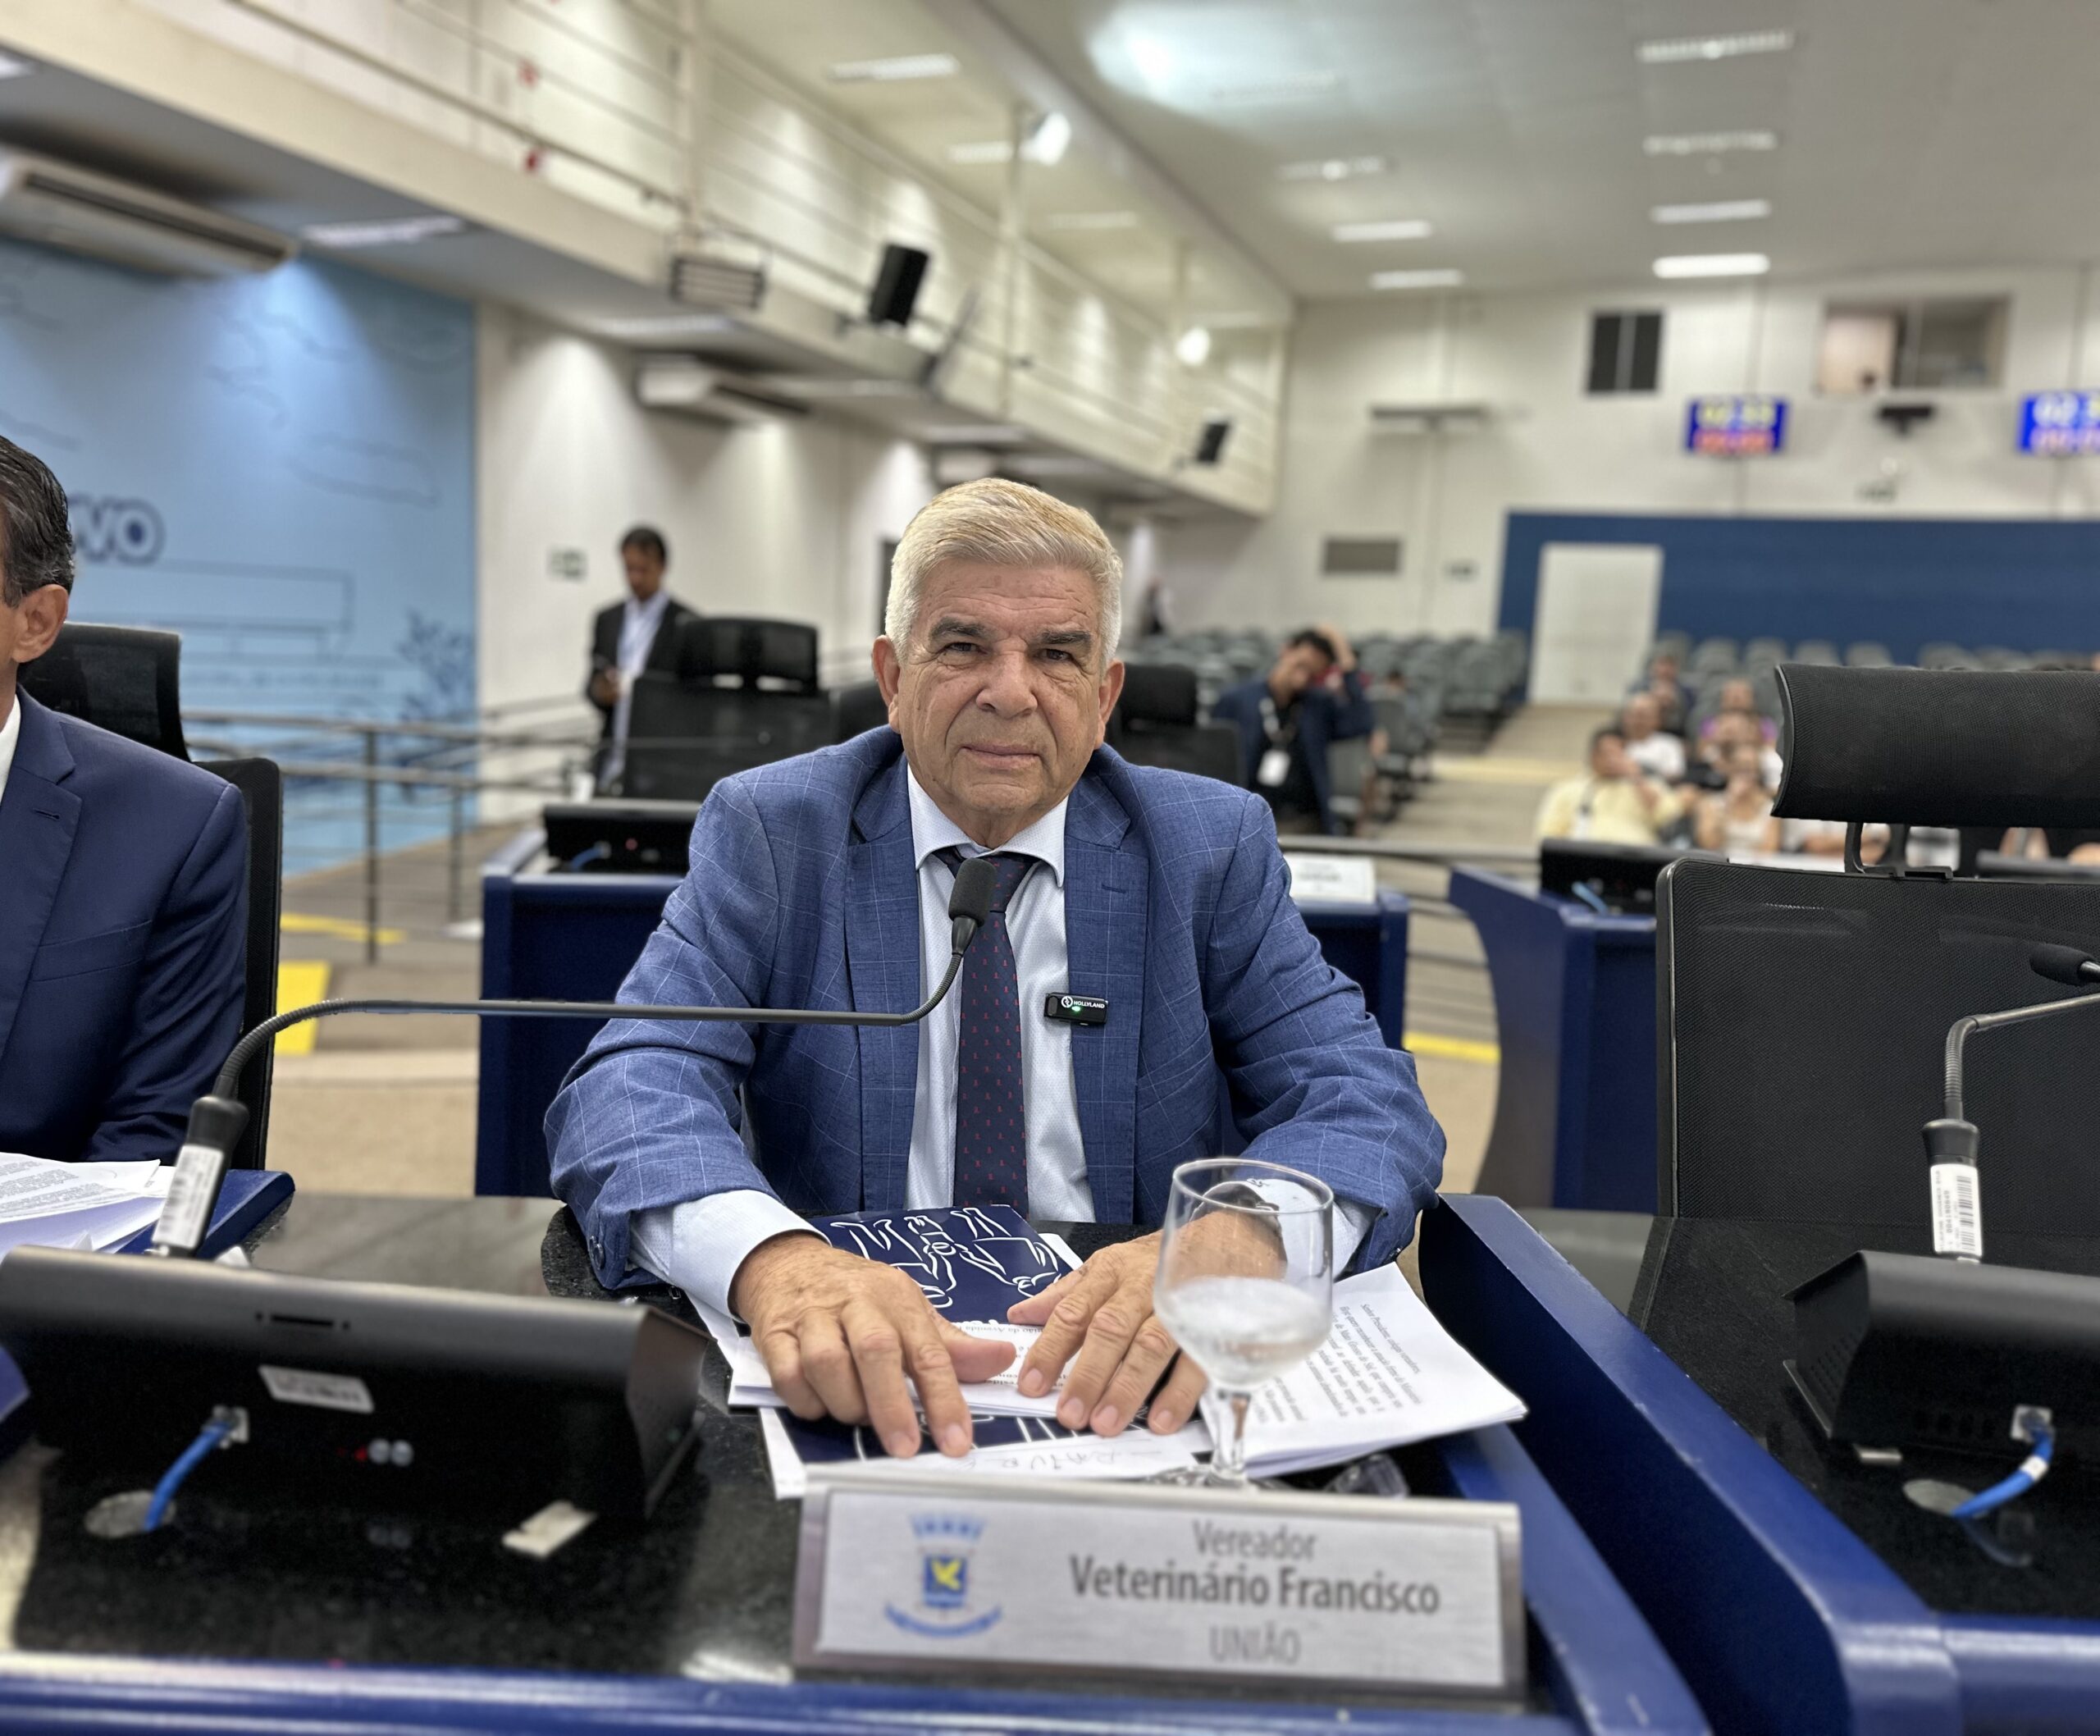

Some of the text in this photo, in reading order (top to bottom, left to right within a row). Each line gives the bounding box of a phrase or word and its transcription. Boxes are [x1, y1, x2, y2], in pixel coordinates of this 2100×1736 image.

[1073, 1000, 1105, 1008] HOLLYLAND
[1193, 1519, 1317, 1560] Vereador
[1069, 1555, 1440, 1615] Veterinário Francisco
[1209, 1621, 1301, 1665] UNIÃO
